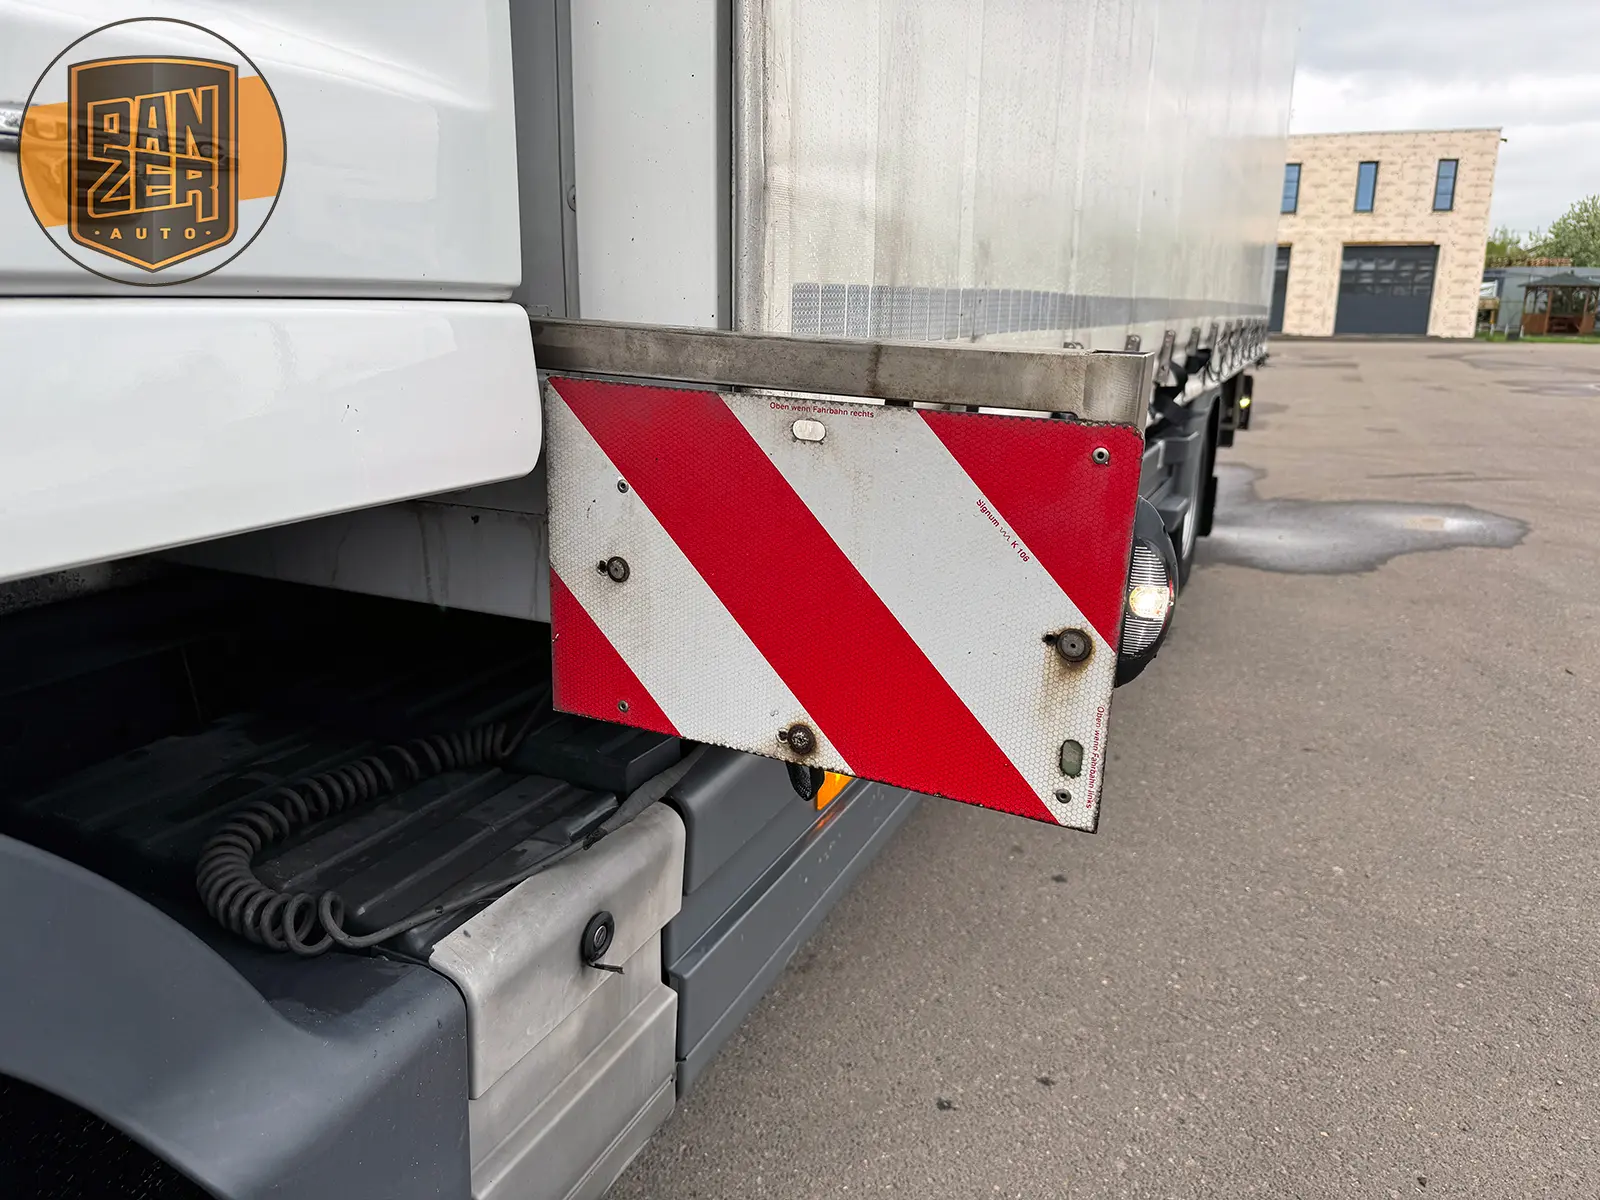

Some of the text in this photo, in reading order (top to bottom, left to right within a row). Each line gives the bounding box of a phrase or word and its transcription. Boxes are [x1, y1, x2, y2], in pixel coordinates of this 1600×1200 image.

[769, 402, 789, 410] Oben
[813, 406, 848, 415] Fahrbahn
[976, 499, 1030, 562] Signum K 106
[1096, 706, 1105, 728] Oben
[1089, 753, 1099, 788] Fahrbahn
[1086, 790, 1094, 809] links
